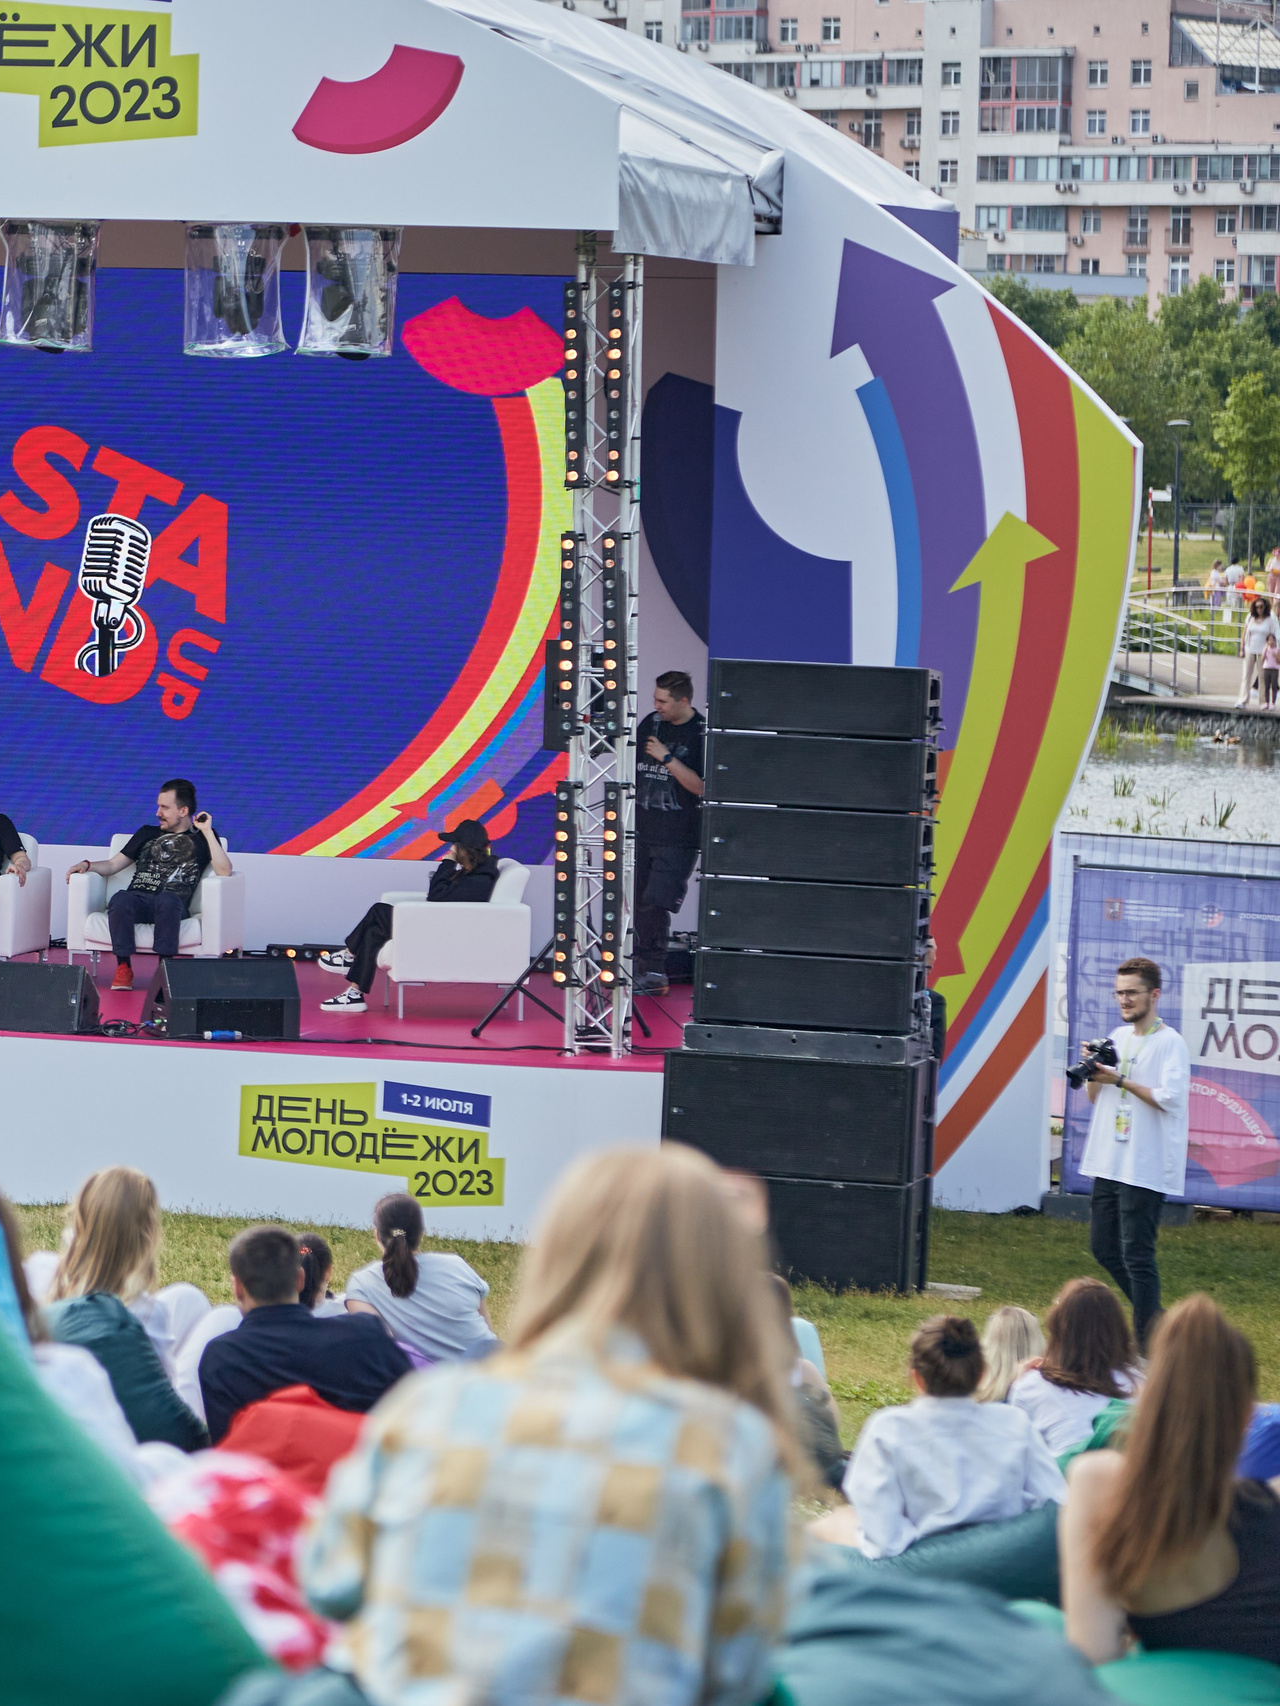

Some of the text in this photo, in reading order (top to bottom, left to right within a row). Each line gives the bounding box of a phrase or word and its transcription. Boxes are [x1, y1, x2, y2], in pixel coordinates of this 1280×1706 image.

[50, 76, 181, 129] 2023
[156, 628, 222, 721] UP
[1201, 977, 1280, 1021] ДЕ
[1200, 1021, 1280, 1060] МО
[252, 1092, 474, 1126] ДЕНЬ 1-2 ИЮЛЯ
[251, 1125, 481, 1165] МОЛОДЁЖИ
[414, 1169, 495, 1198] 2023
